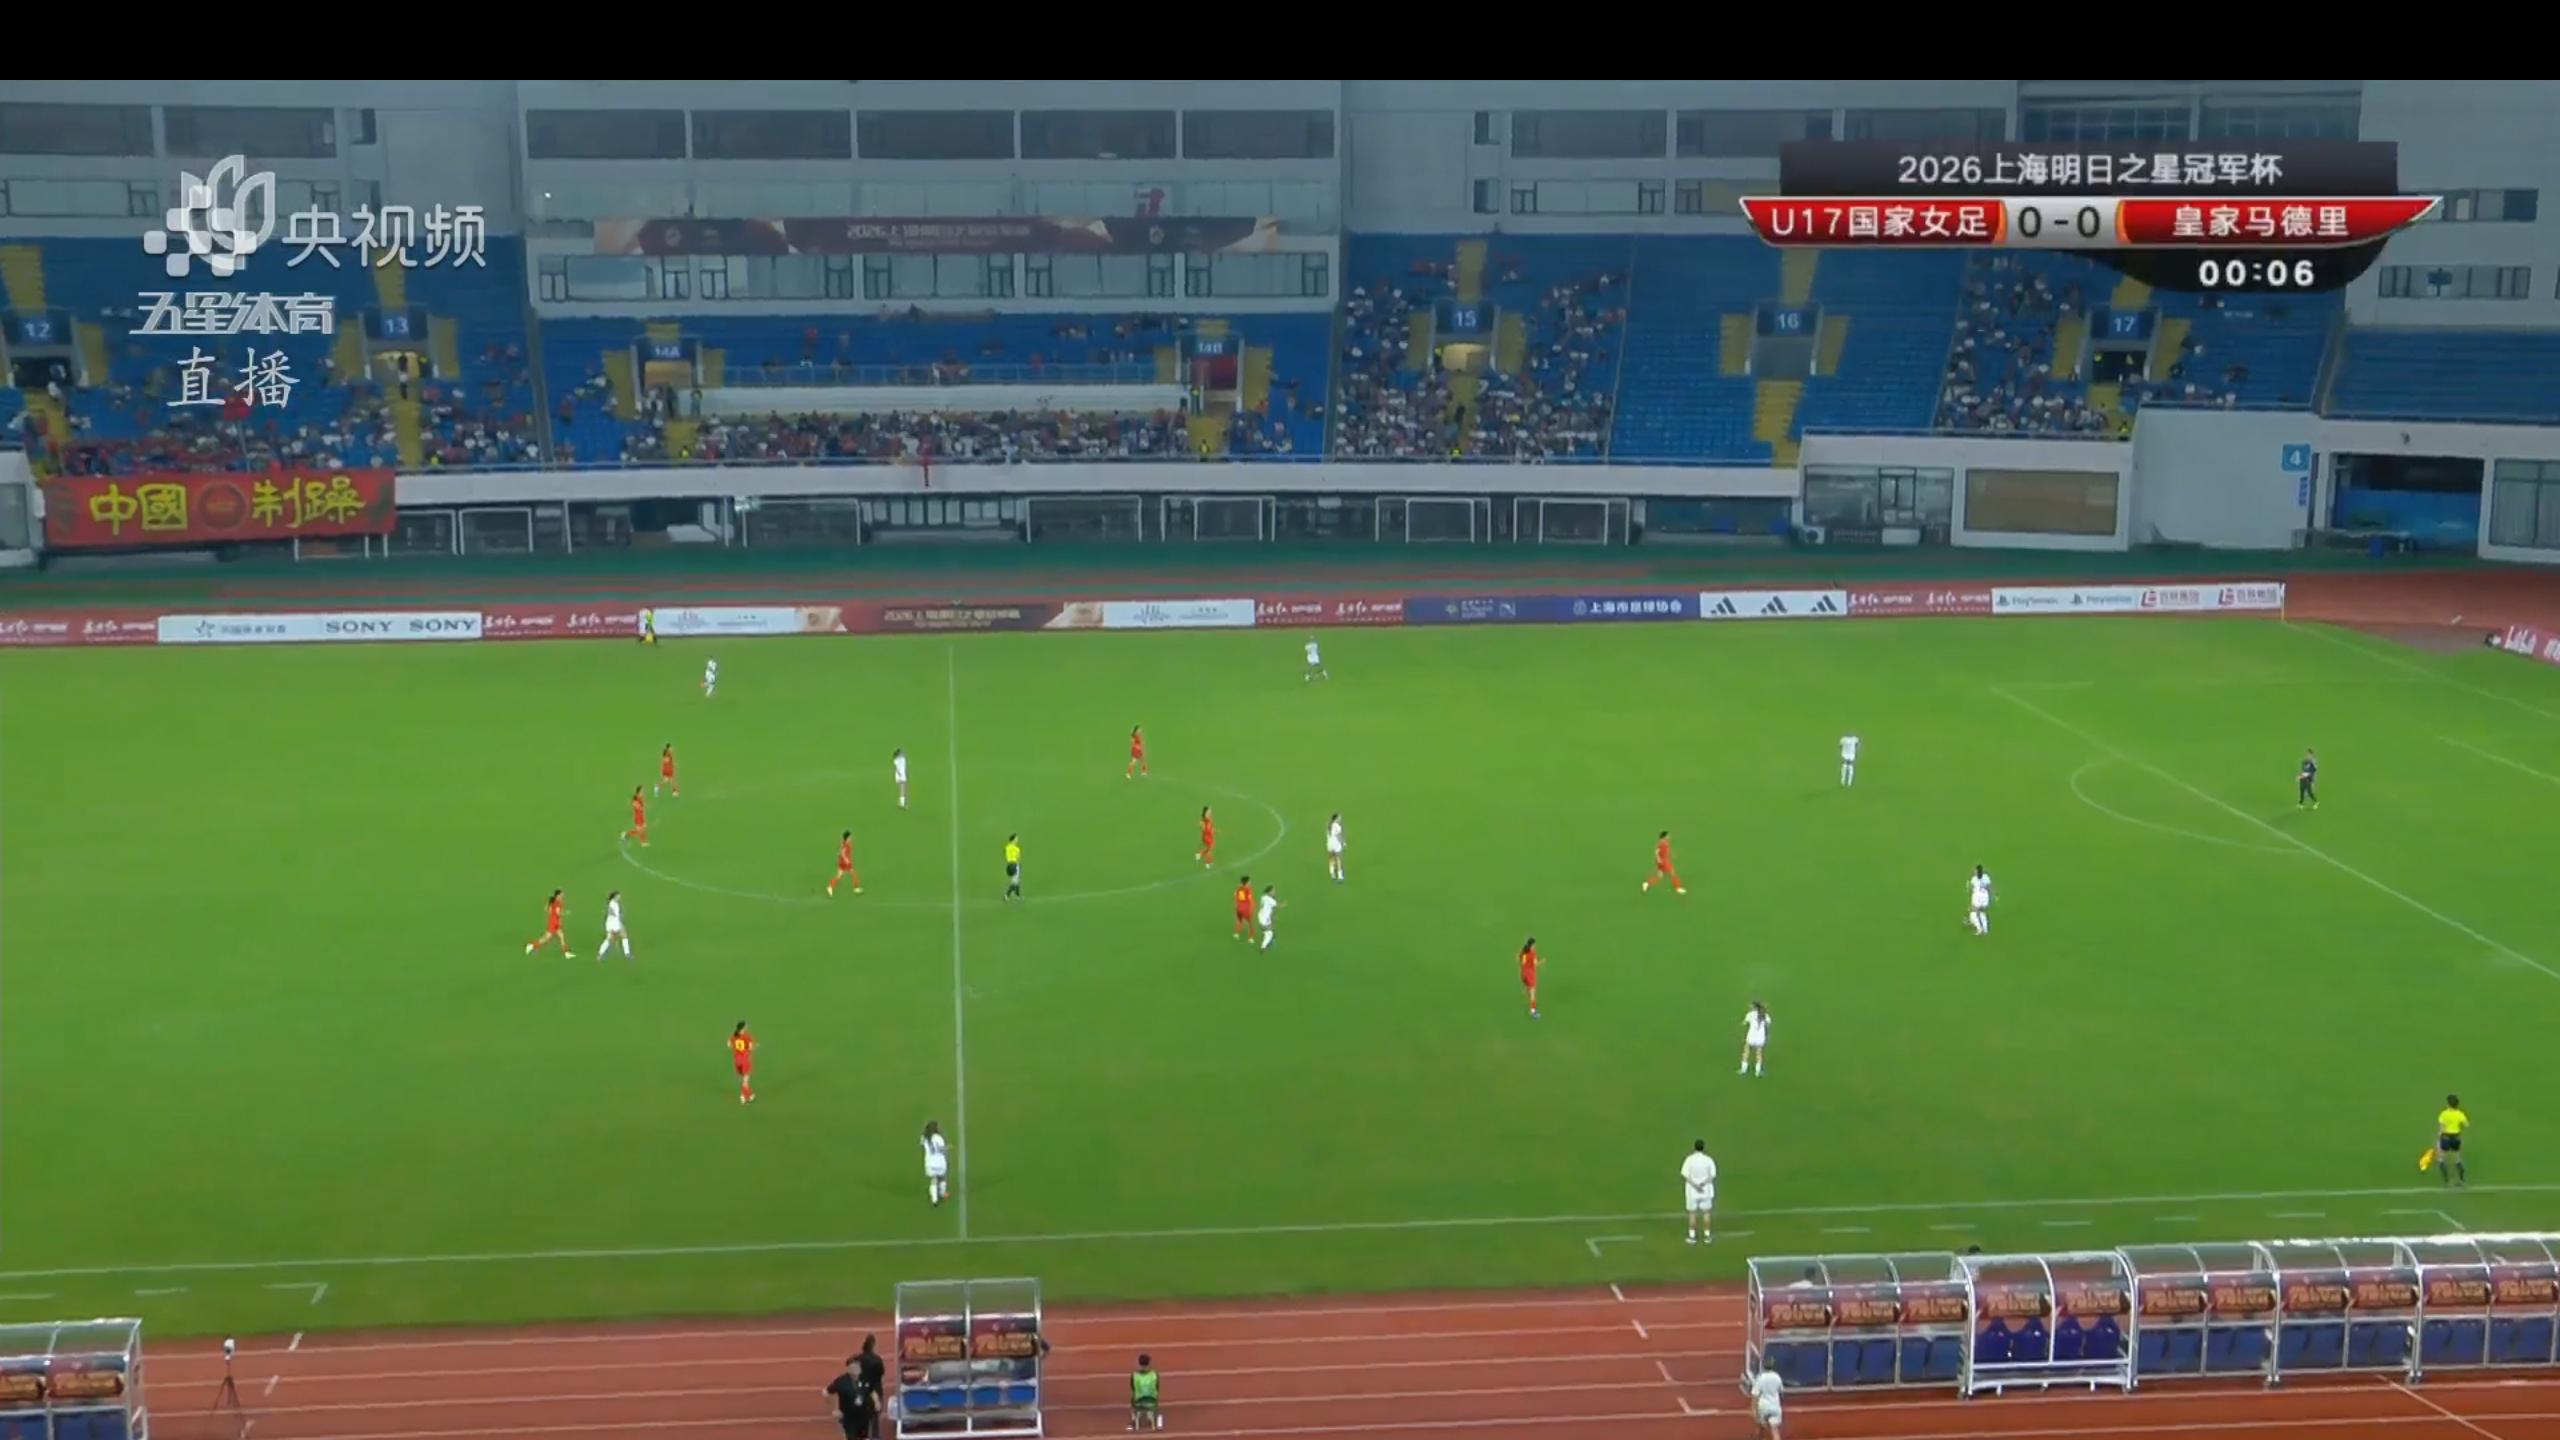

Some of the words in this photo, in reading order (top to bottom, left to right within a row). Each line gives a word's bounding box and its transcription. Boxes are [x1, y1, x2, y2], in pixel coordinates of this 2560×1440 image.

[385, 317, 409, 334] 13
[1453, 310, 1477, 328] 15
[1776, 312, 1800, 330] 16
[2113, 315, 2135, 333] 17
[24, 322, 50, 339] 12
[2289, 449, 2302, 467] 4
[89, 482, 189, 536] 中國
[325, 620, 392, 634] SONY
[409, 618, 476, 633] SONY
